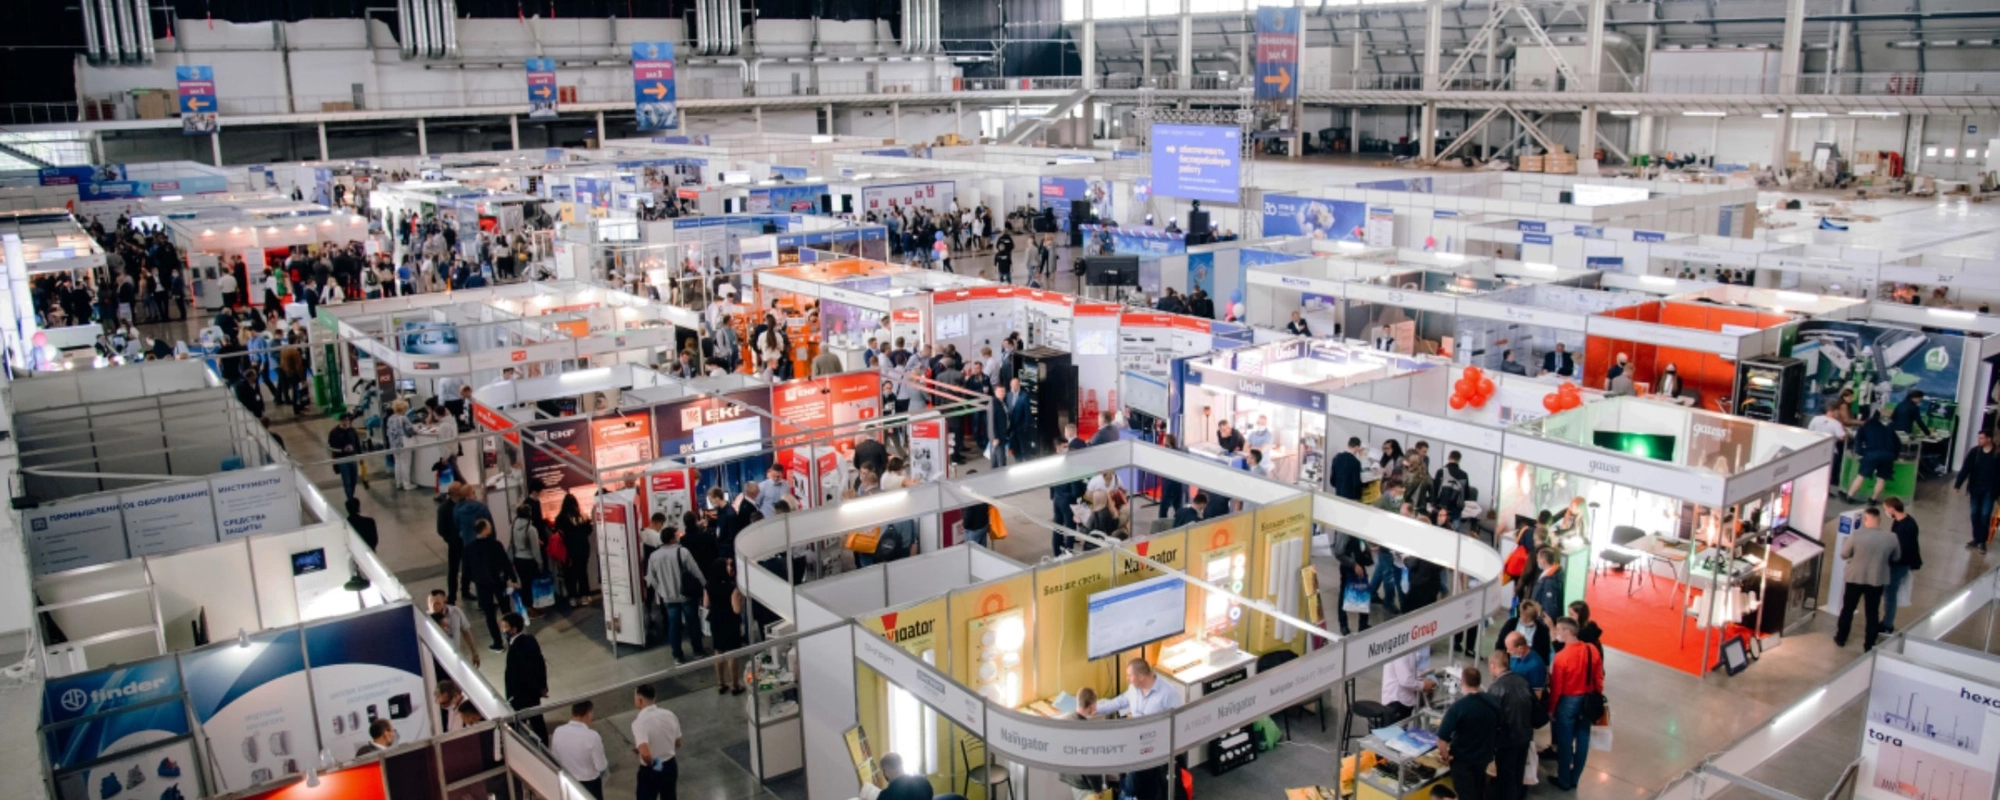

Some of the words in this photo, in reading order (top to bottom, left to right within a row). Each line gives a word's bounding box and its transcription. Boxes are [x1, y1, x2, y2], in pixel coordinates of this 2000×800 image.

[1239, 379, 1265, 395] Uniel
[705, 405, 746, 421] EKF
[549, 429, 576, 440] EKF
[1693, 423, 1727, 438] gauss
[1589, 459, 1620, 474] gauss
[218, 477, 281, 494] ИНСТРУМЕНТЫ
[136, 489, 209, 509] ОБОРУДОВАНИЕ
[223, 513, 266, 527] СРЕДСТВА
[225, 522, 262, 536] ЗАЩИТЫ
[1367, 631, 1410, 658] Navigator
[1411, 620, 1437, 640] Group
[90, 678, 165, 704] finder
[1217, 694, 1256, 719] Navigator
[1001, 727, 1049, 753] Navigator
[1869, 728, 1903, 747] tora
